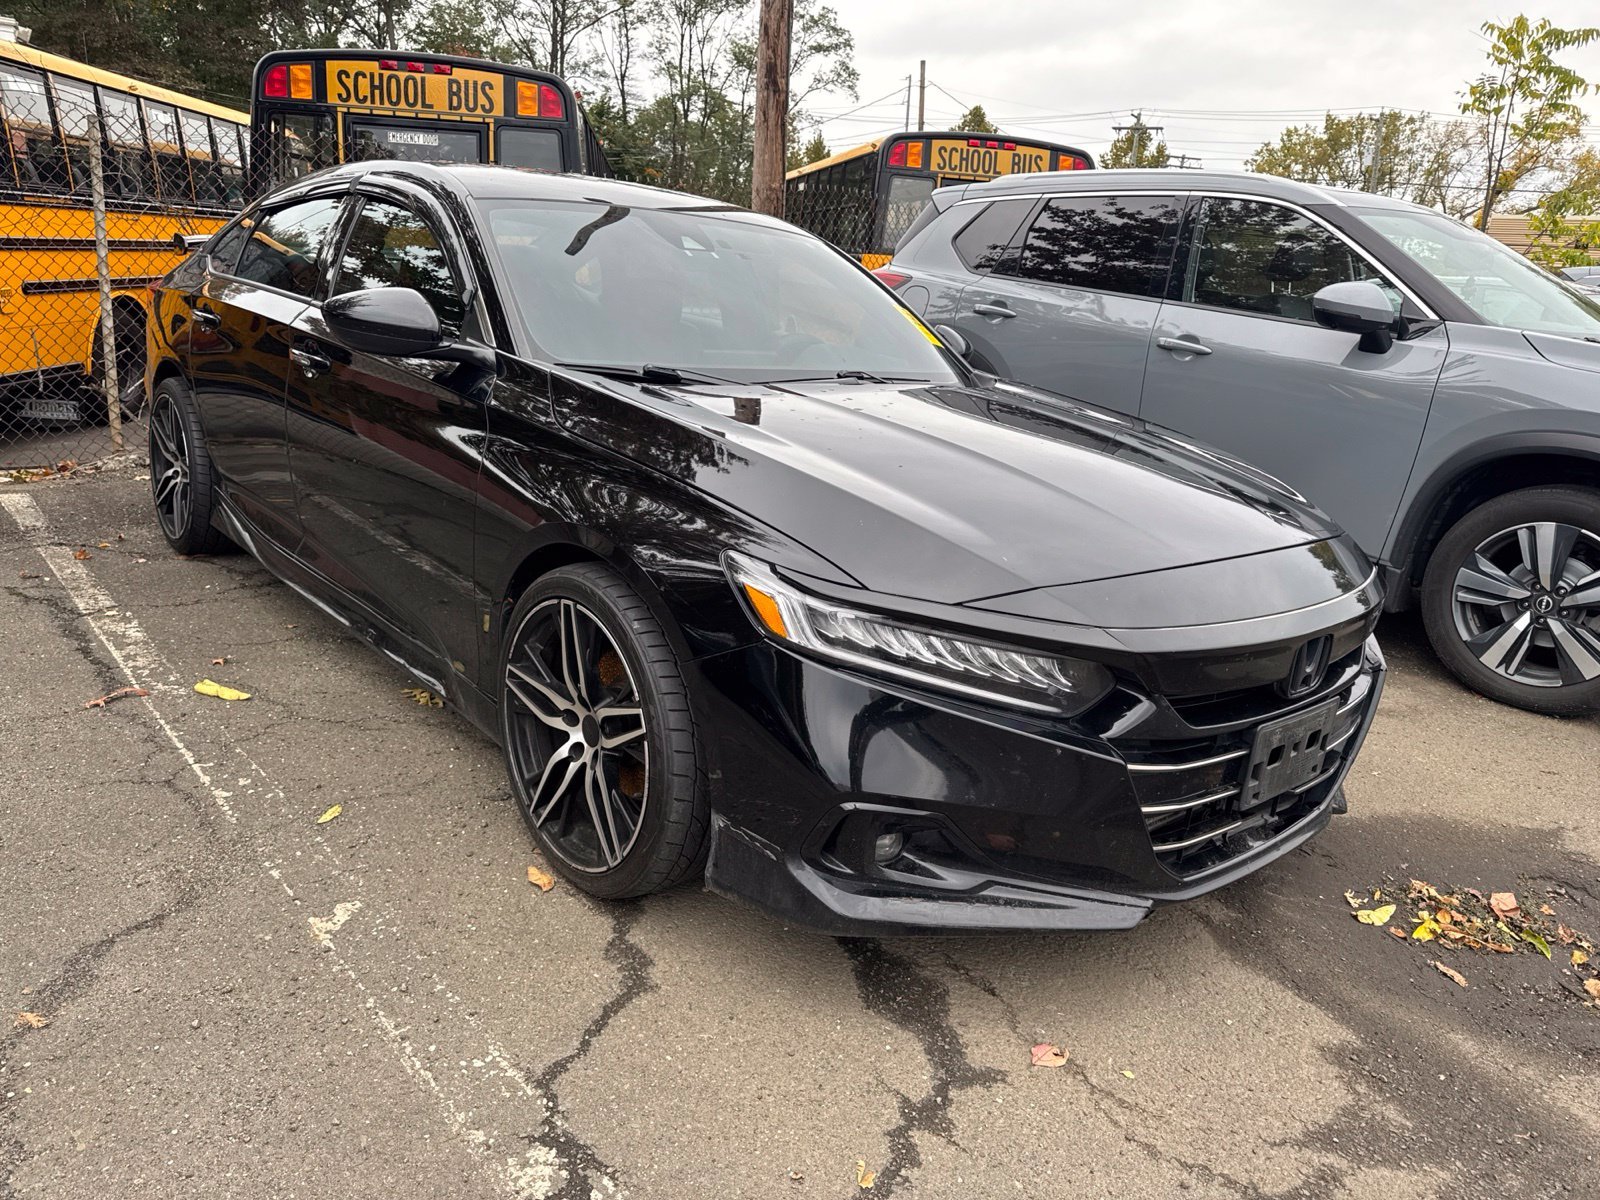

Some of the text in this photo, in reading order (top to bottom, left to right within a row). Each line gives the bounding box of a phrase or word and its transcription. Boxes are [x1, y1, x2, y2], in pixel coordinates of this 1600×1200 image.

[337, 70, 495, 114] SCHOOL BUS
[937, 146, 1043, 175] SCHOOL BUS
